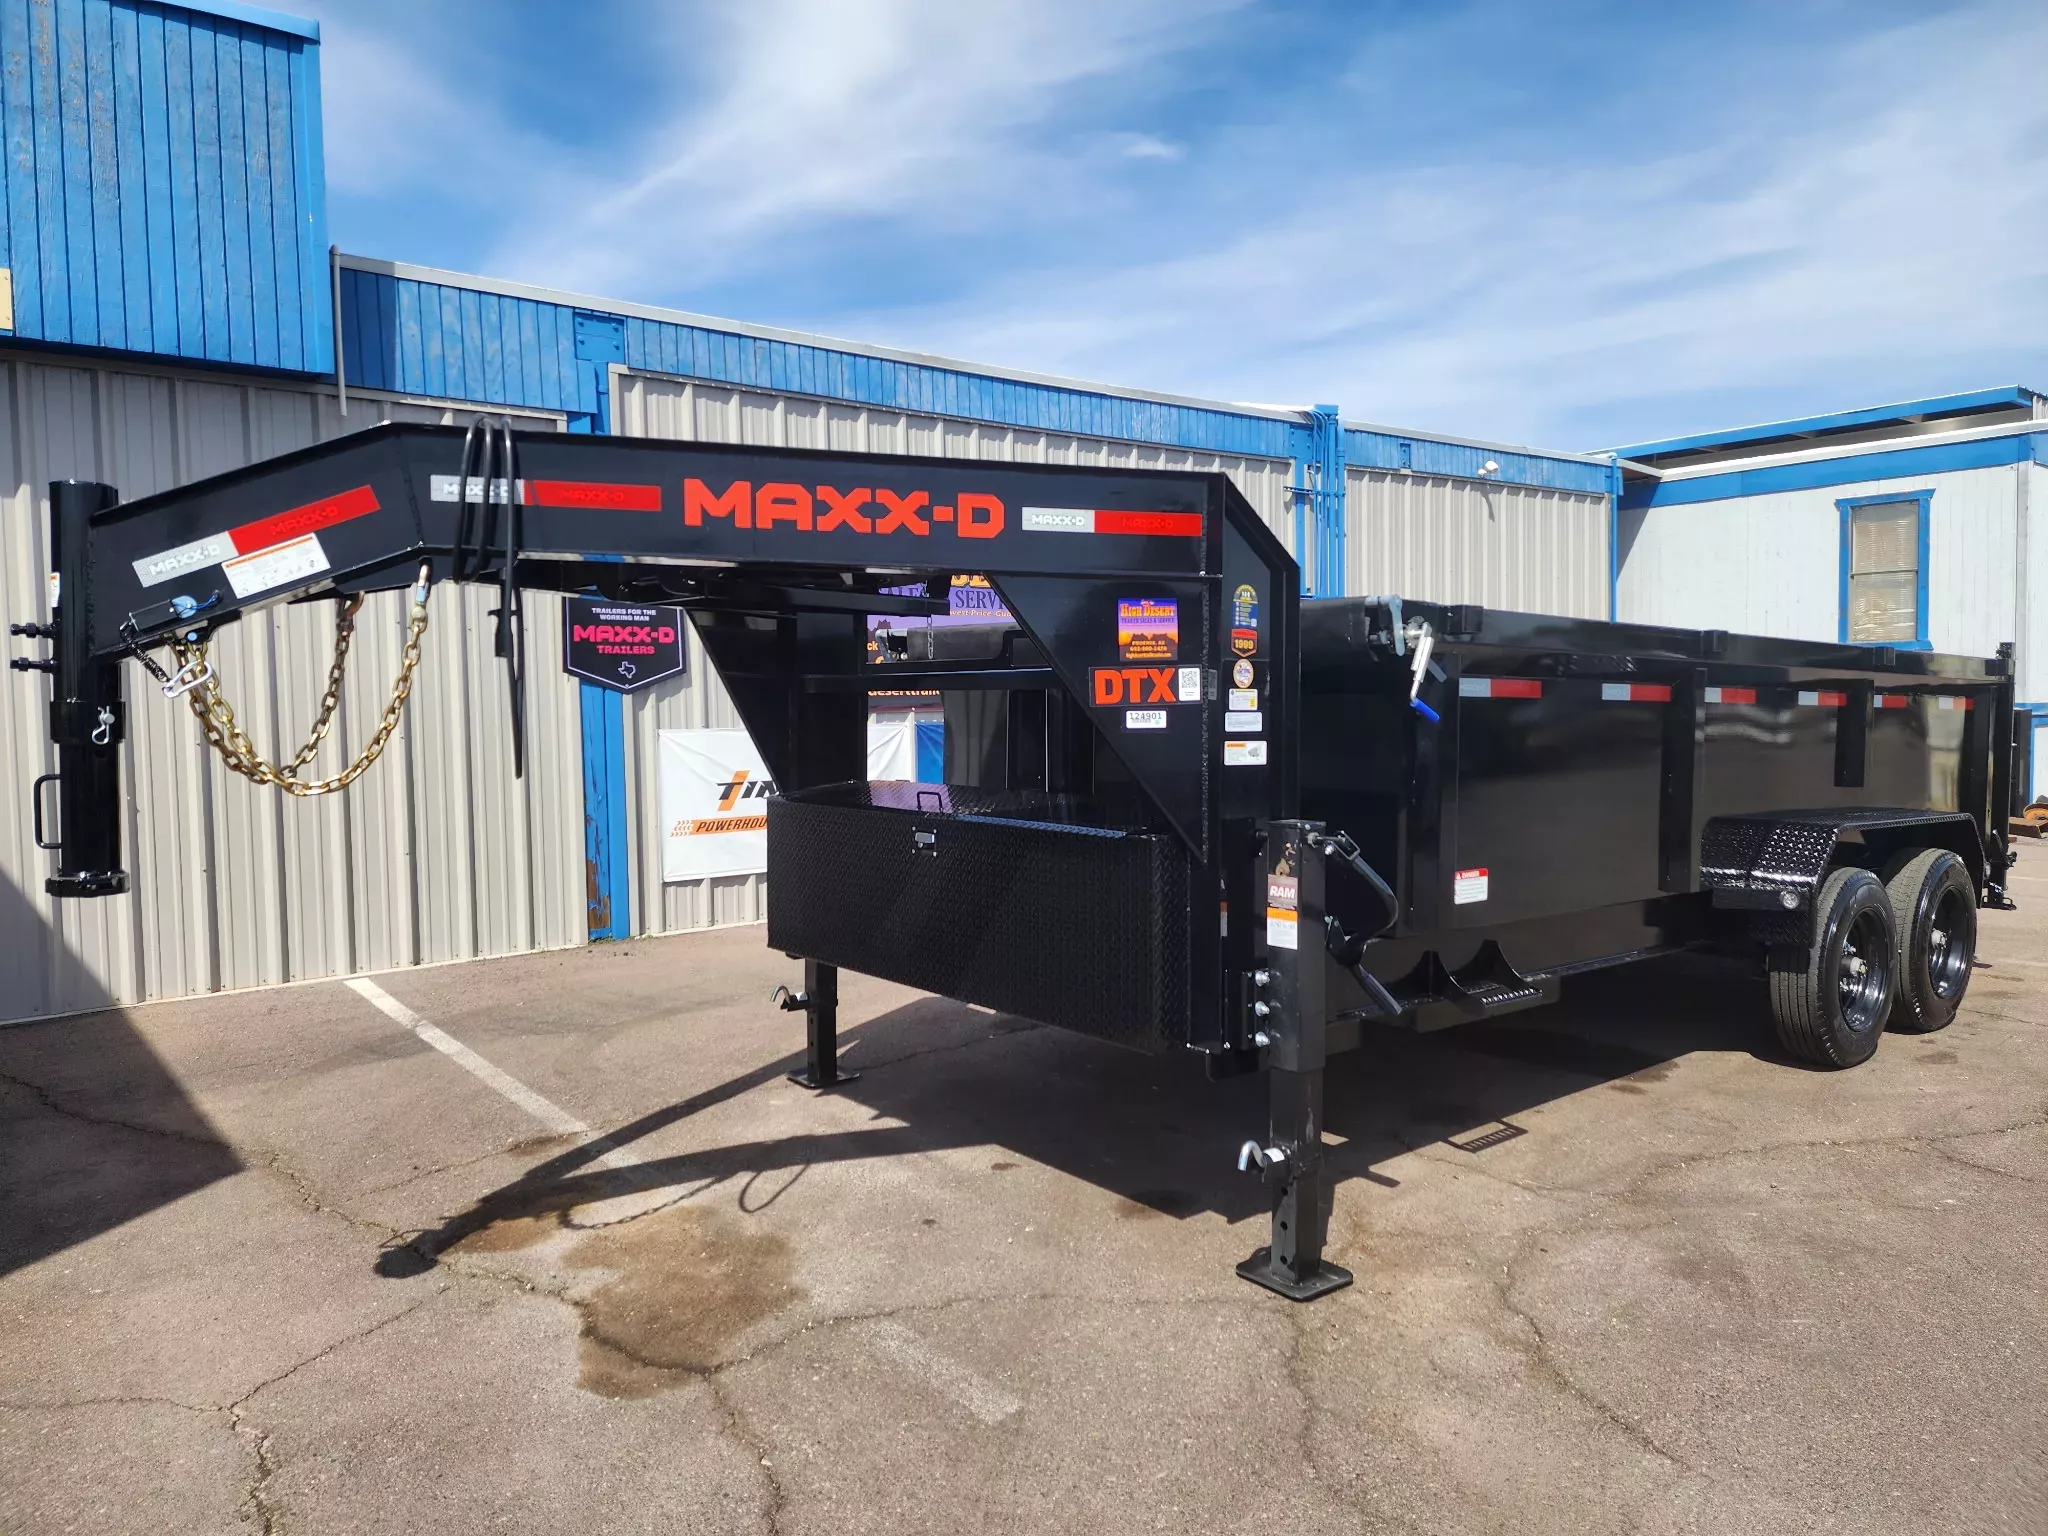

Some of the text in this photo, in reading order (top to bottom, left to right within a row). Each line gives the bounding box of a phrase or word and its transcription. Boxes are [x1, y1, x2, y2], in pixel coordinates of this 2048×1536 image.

[683, 478, 1005, 539] MAXX-D
[270, 505, 339, 536] MAXX-D
[1031, 514, 1085, 526] MAXX-D
[148, 543, 221, 577] MAXX-D
[591, 607, 627, 615] TRAILERS
[1120, 603, 1176, 617] HIGH DESERT
[573, 624, 675, 644] MAXX-D
[596, 645, 656, 655] TRAILERS
[1234, 639, 1254, 650] 1999
[1094, 667, 1177, 705] DTX
[1129, 712, 1163, 720] 124901
[1269, 885, 1296, 899] RAM
